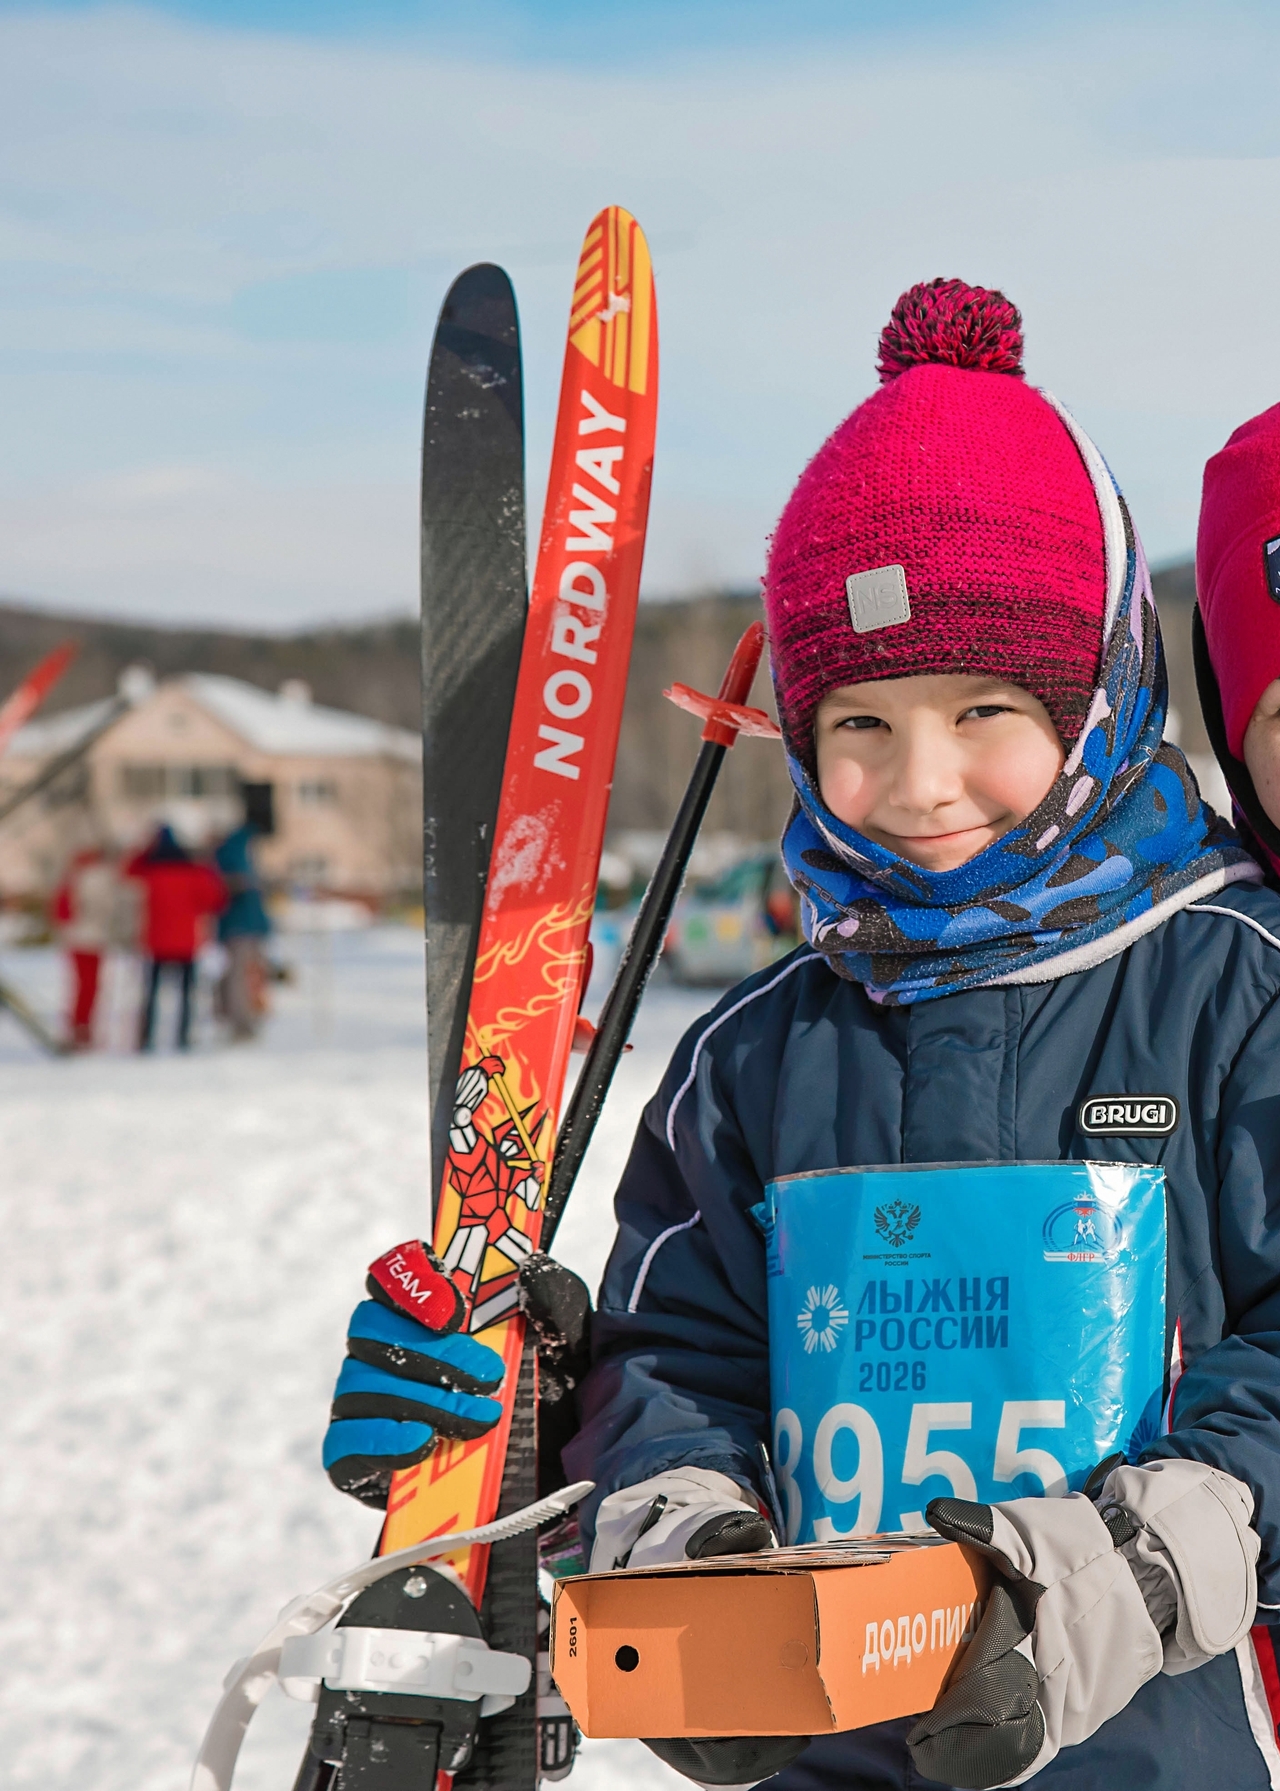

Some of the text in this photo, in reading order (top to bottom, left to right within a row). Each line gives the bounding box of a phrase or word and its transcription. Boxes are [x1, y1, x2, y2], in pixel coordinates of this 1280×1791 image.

[533, 389, 628, 780] NORDWAY
[1090, 1104, 1167, 1124] BRUGI
[385, 1253, 433, 1304] TEAM
[855, 1276, 1010, 1315] ЛЫЖНЯ
[854, 1314, 1010, 1353] РОССИИ
[858, 1360, 928, 1393] 2026
[569, 1616, 578, 1658] 2601
[862, 1612, 927, 1674] ДОДО
